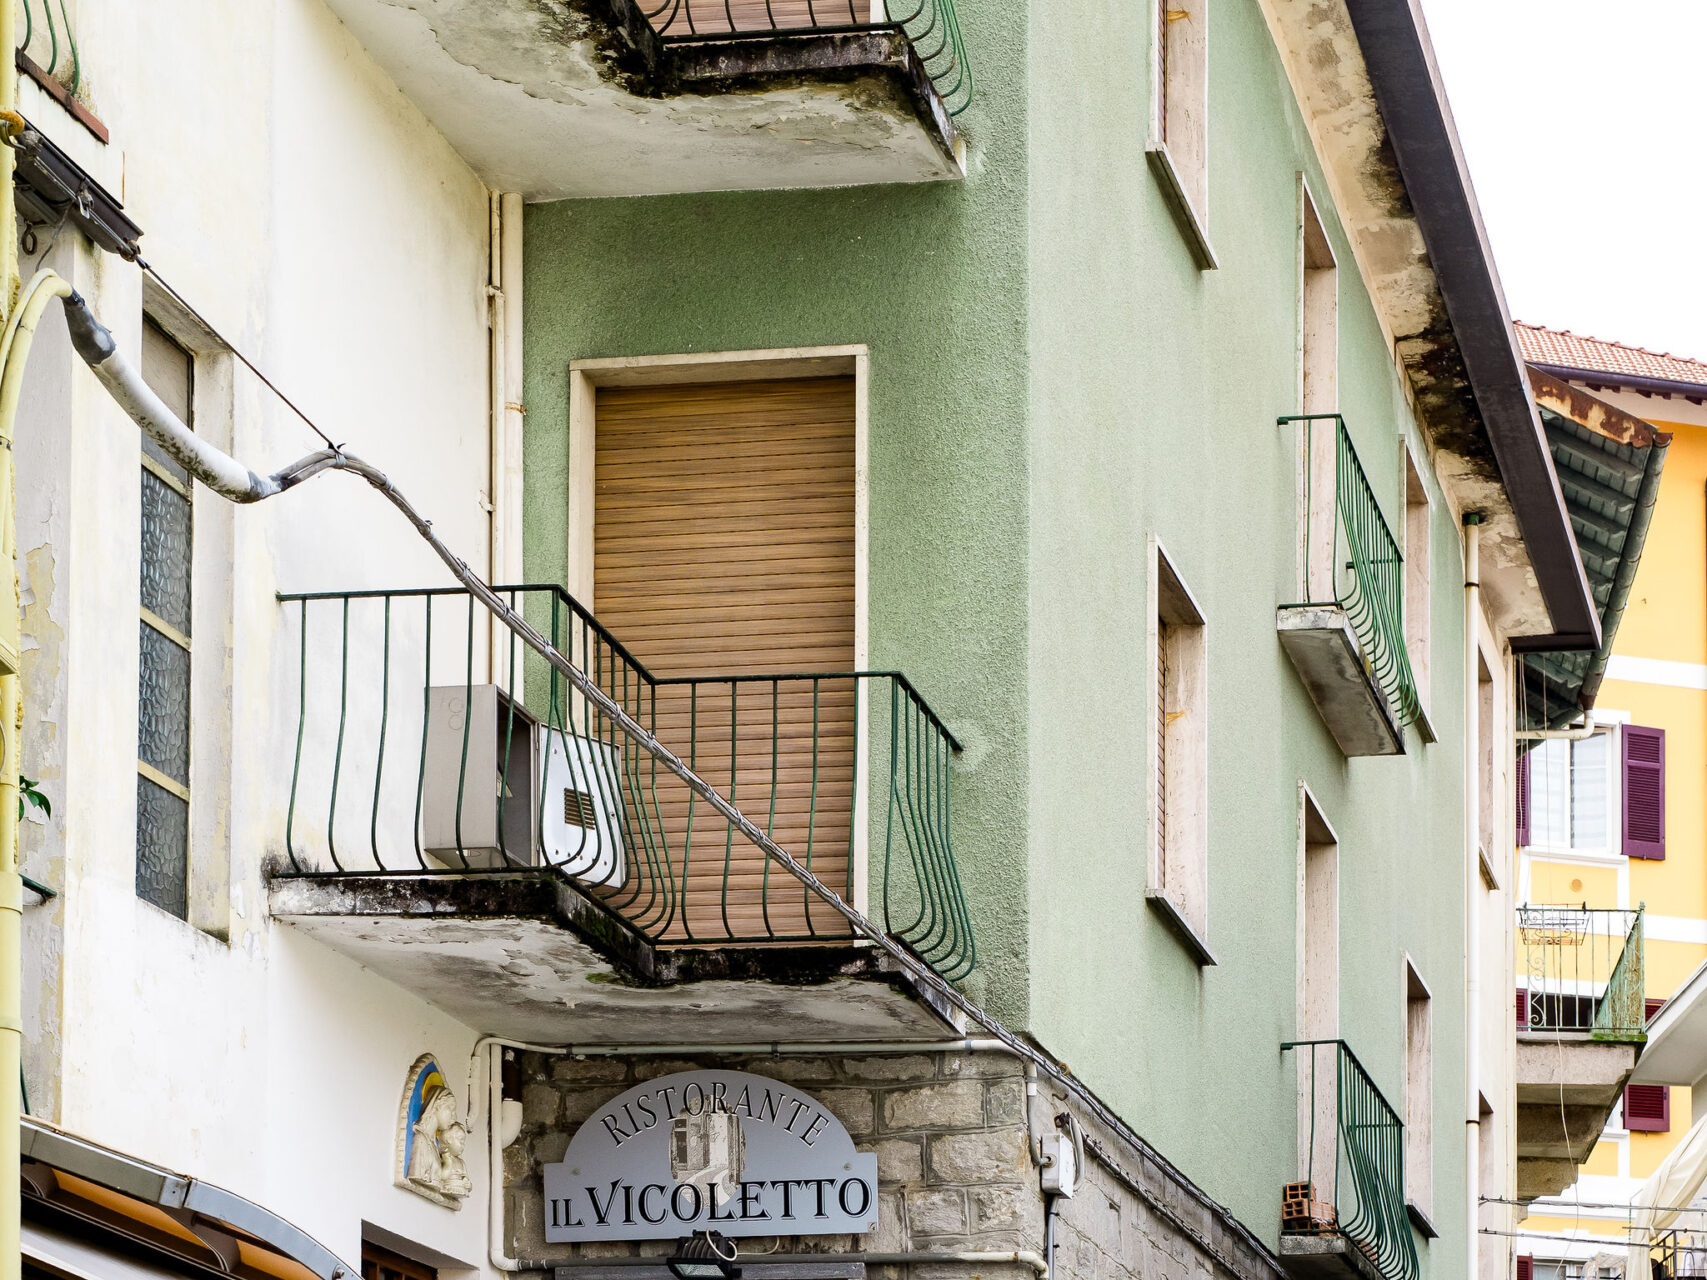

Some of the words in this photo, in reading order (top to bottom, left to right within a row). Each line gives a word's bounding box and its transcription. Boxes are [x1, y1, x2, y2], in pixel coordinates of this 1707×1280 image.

[599, 1081, 830, 1149] RISTORANTE
[550, 1198, 585, 1229] IL
[584, 1176, 874, 1227] VICOLETTO
